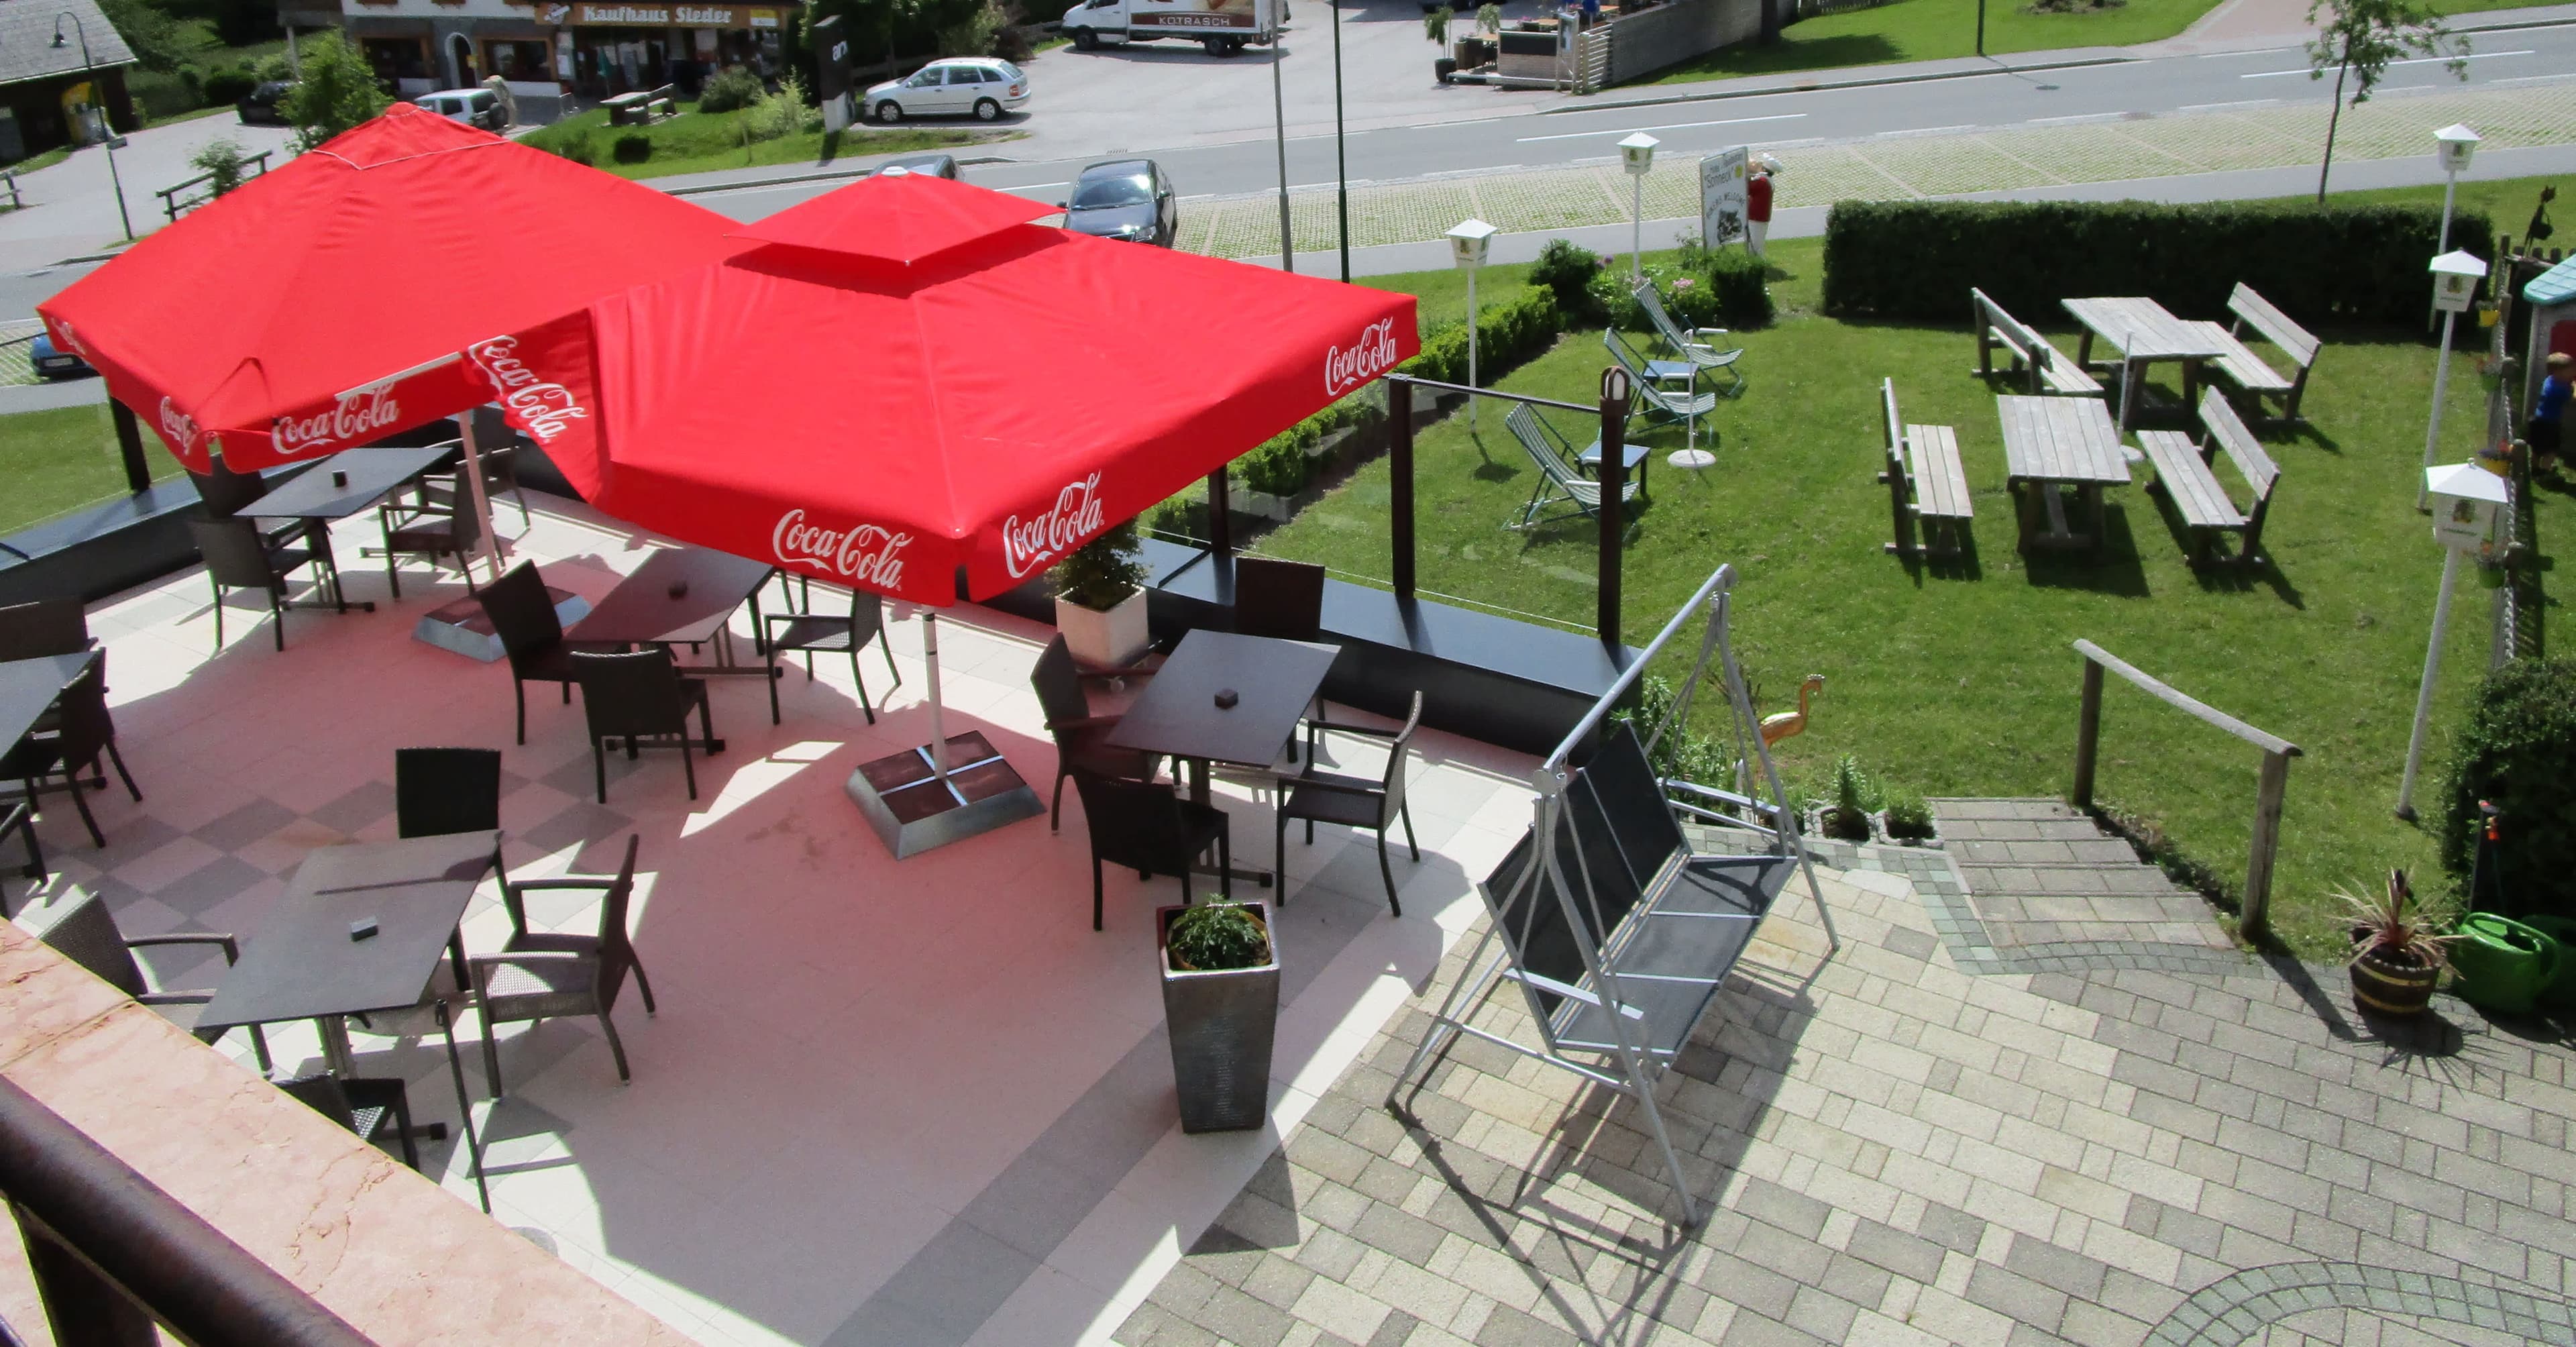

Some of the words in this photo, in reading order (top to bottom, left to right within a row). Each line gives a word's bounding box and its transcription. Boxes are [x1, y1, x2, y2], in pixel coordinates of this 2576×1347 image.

[583, 6, 669, 21] Kaufhaus
[675, 7, 731, 23] Sieder
[1159, 17, 1230, 25] KOTRASCH
[468, 335, 589, 441] Coca-Cola
[1325, 317, 1396, 396] Coca-Cola
[272, 383, 398, 455] Coca-Cola
[773, 509, 914, 589] Coca-Cola
[1004, 470, 1102, 578] Coca-Cola
